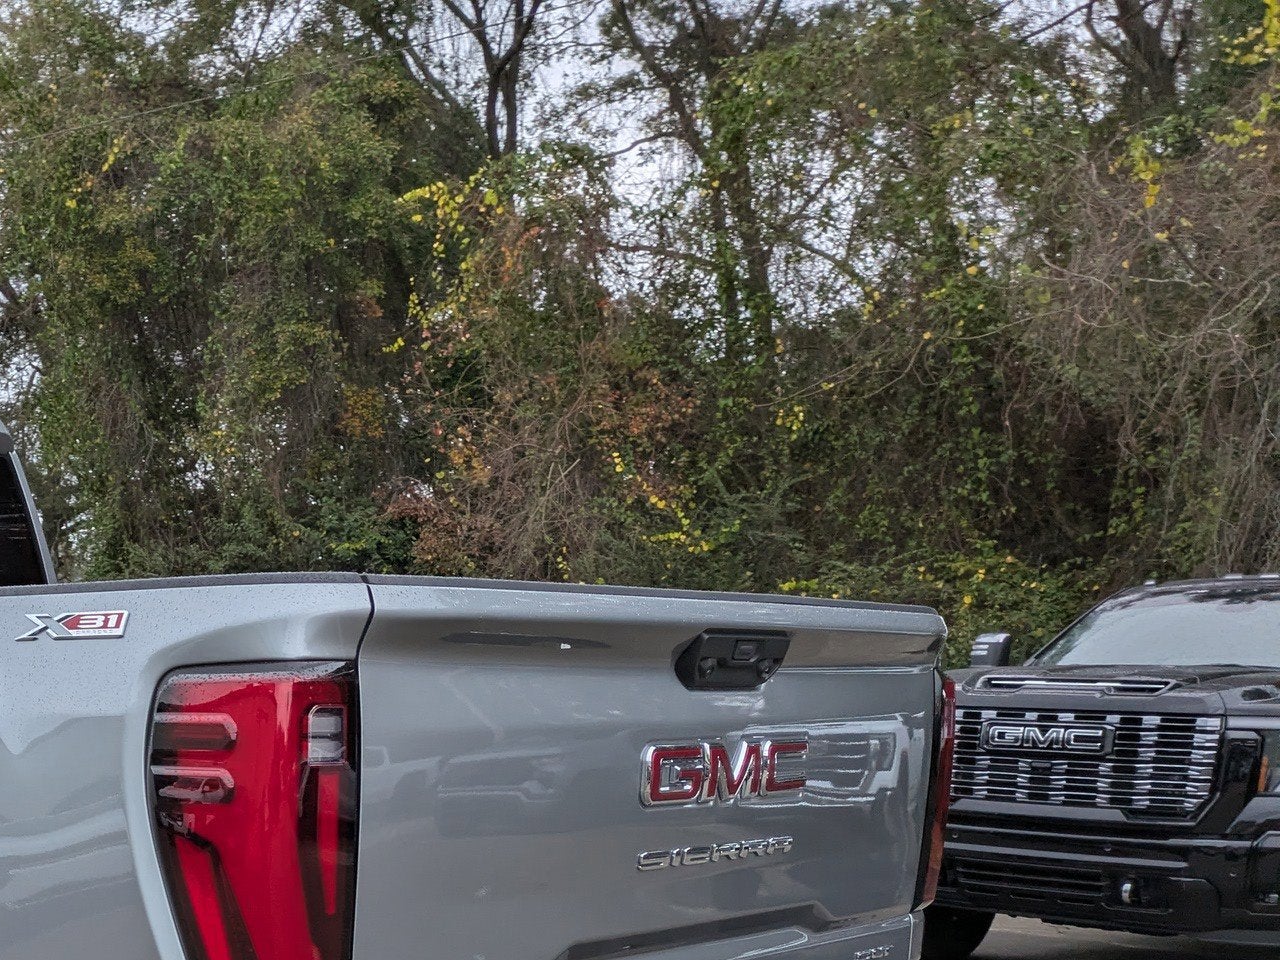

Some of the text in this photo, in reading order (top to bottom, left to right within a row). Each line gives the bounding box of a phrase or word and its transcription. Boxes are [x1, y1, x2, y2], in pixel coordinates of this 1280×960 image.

[989, 726, 1103, 750] GMC
[640, 733, 809, 810] GMC
[637, 835, 794, 871] SIERRA
